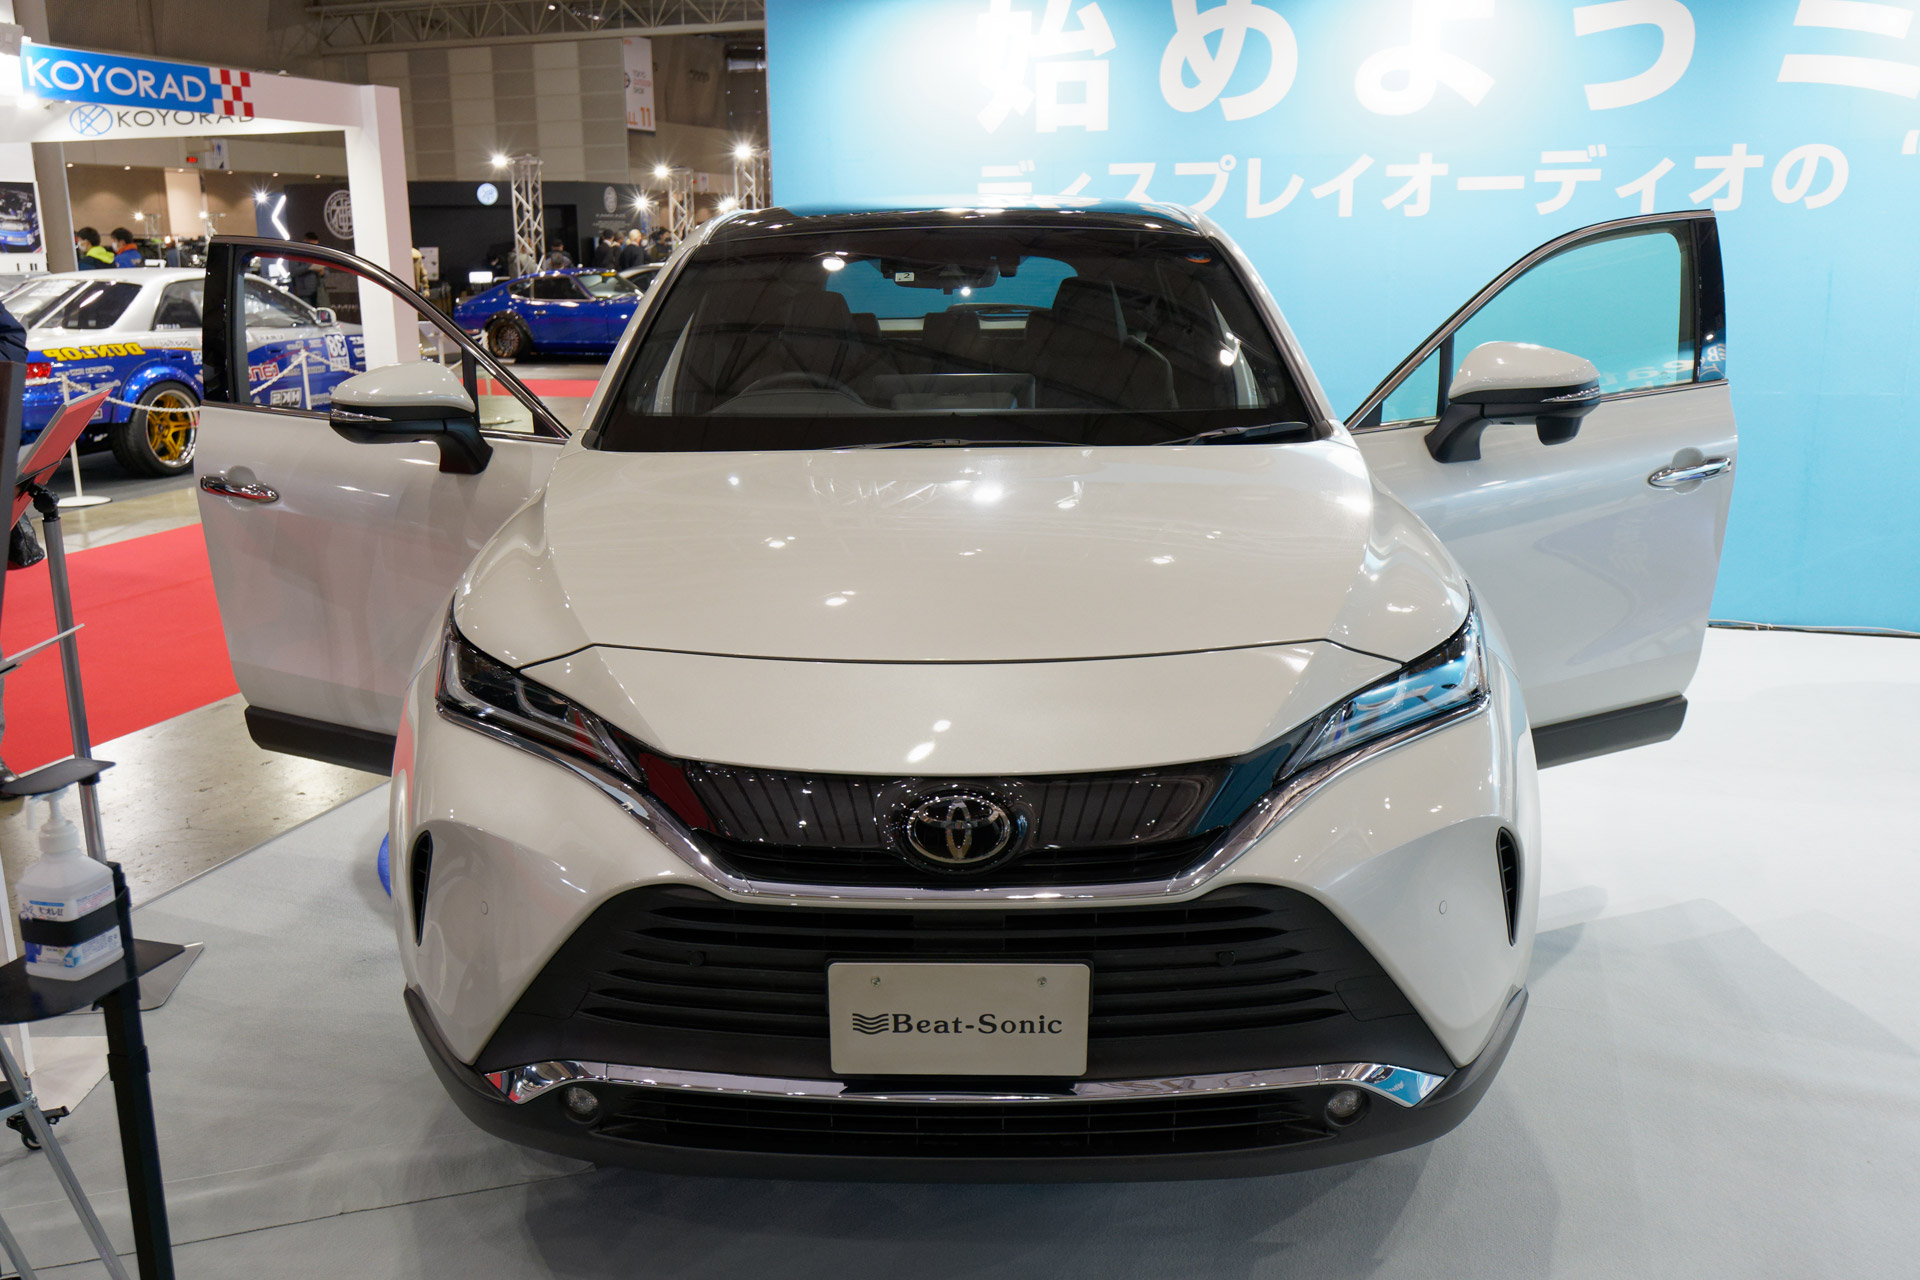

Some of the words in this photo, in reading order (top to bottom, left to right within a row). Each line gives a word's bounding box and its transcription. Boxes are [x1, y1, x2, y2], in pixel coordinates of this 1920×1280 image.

[26, 56, 206, 103] KOYORAD
[640, 106, 652, 127] 11
[892, 1013, 1063, 1035] Beat-Sonic
